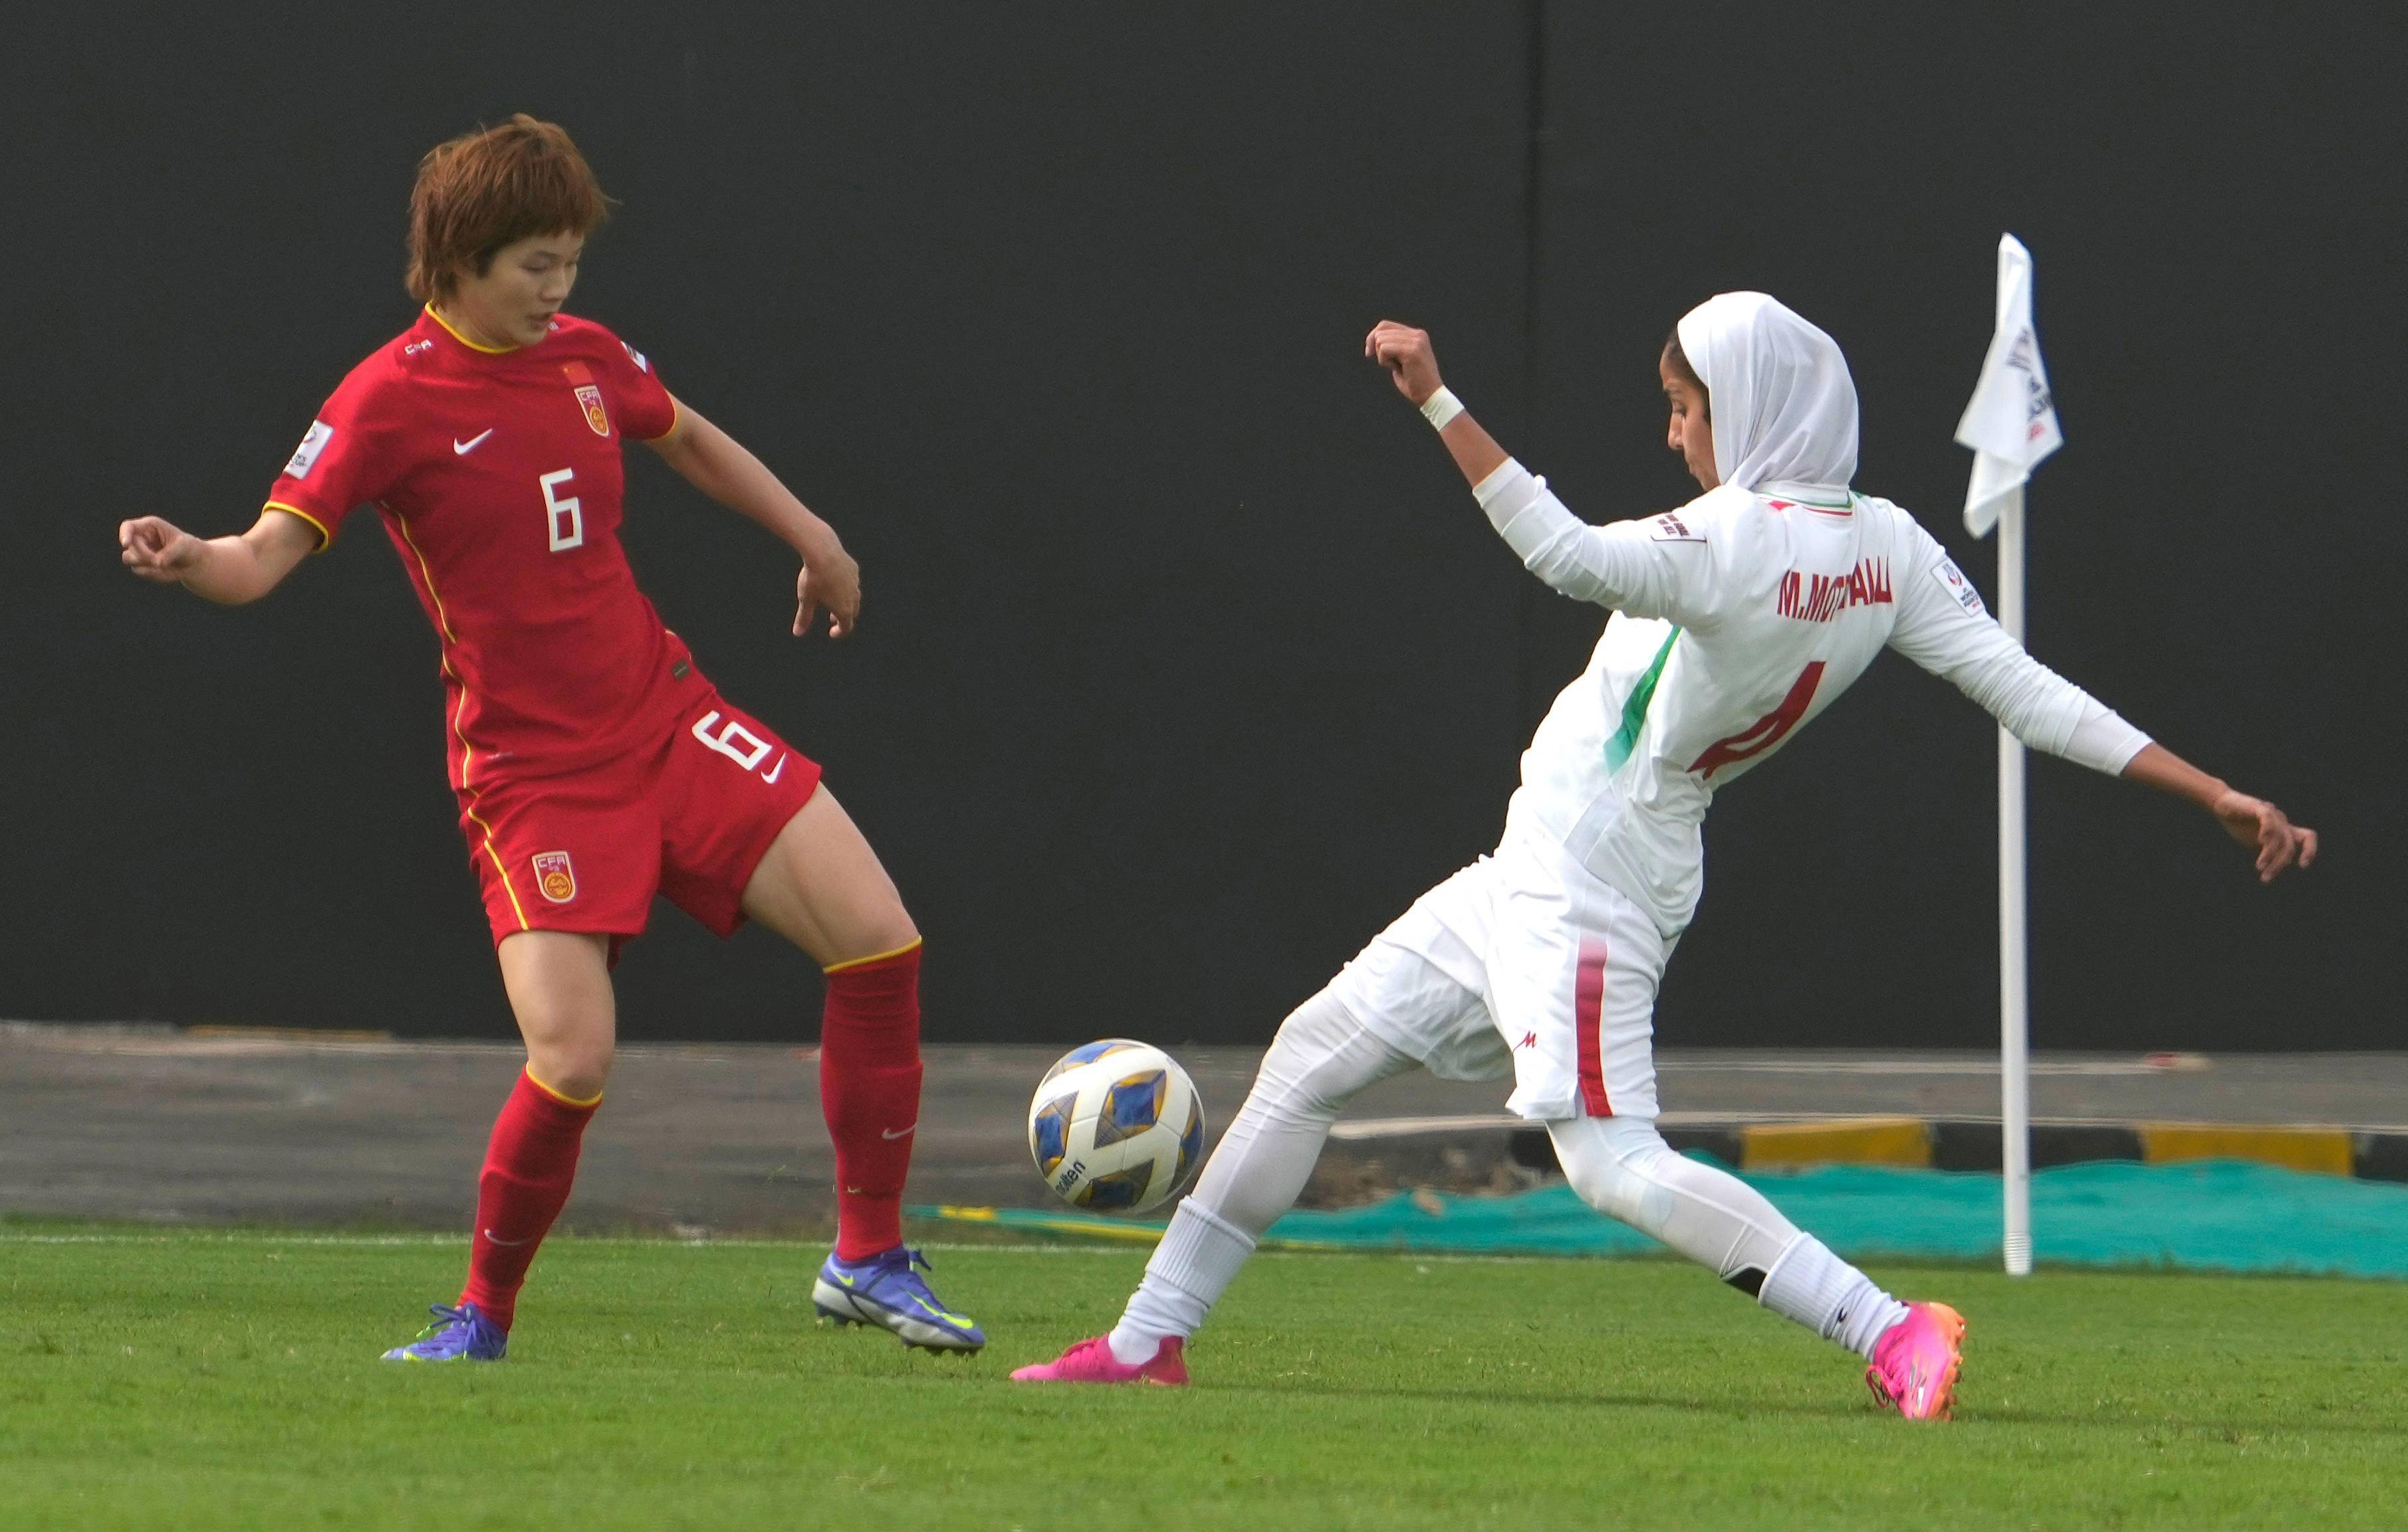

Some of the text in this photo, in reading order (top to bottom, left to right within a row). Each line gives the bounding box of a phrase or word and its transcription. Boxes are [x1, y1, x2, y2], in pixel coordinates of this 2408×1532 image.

[539, 468, 584, 552] 6
[691, 711, 773, 770] 6
[1686, 661, 1827, 780] 4
